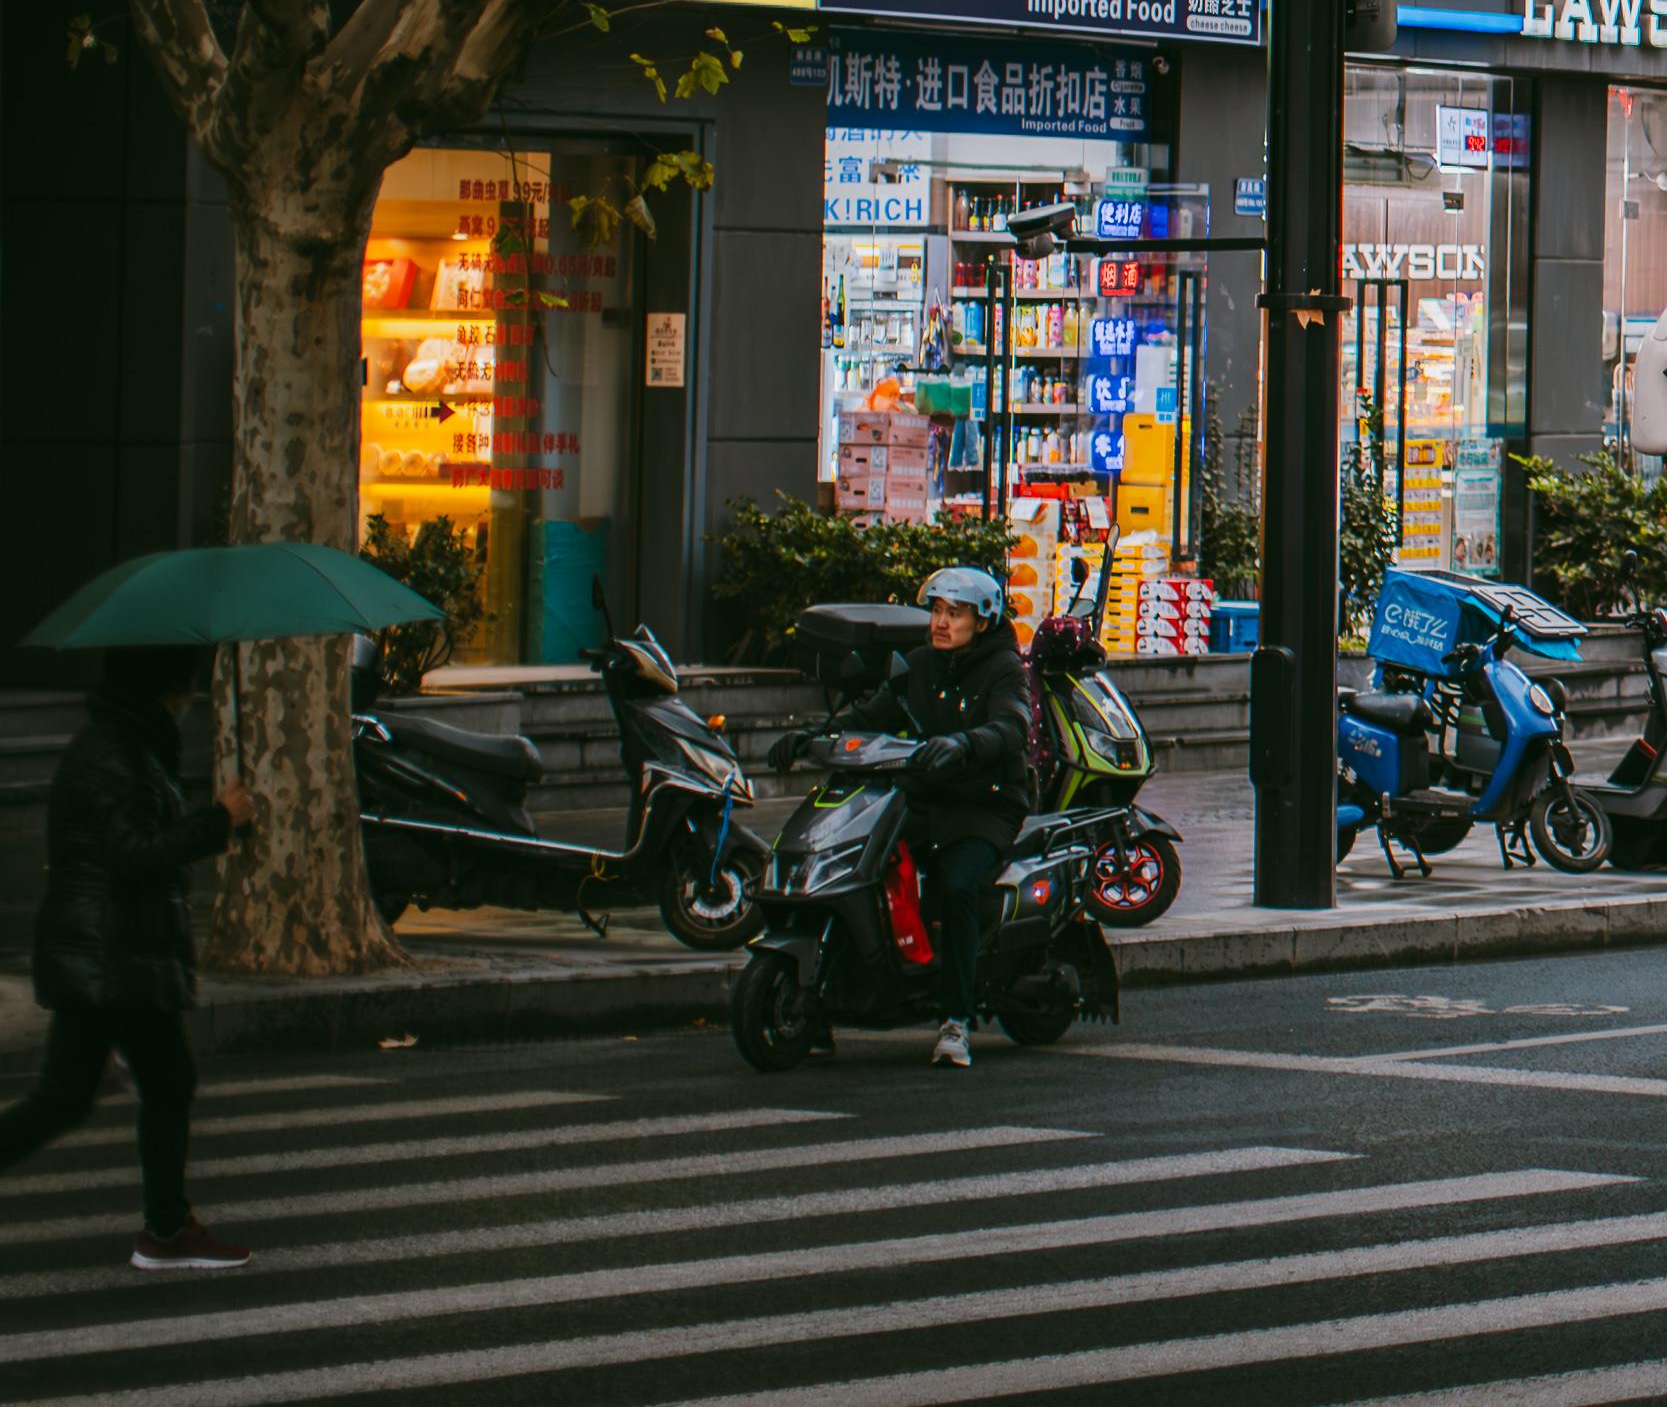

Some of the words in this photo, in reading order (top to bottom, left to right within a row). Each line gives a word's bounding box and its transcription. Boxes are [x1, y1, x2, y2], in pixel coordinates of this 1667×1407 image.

[1021, 118, 1075, 134] Imported
[1078, 120, 1107, 134] Food
[1101, 261, 1138, 288] 烟酒
